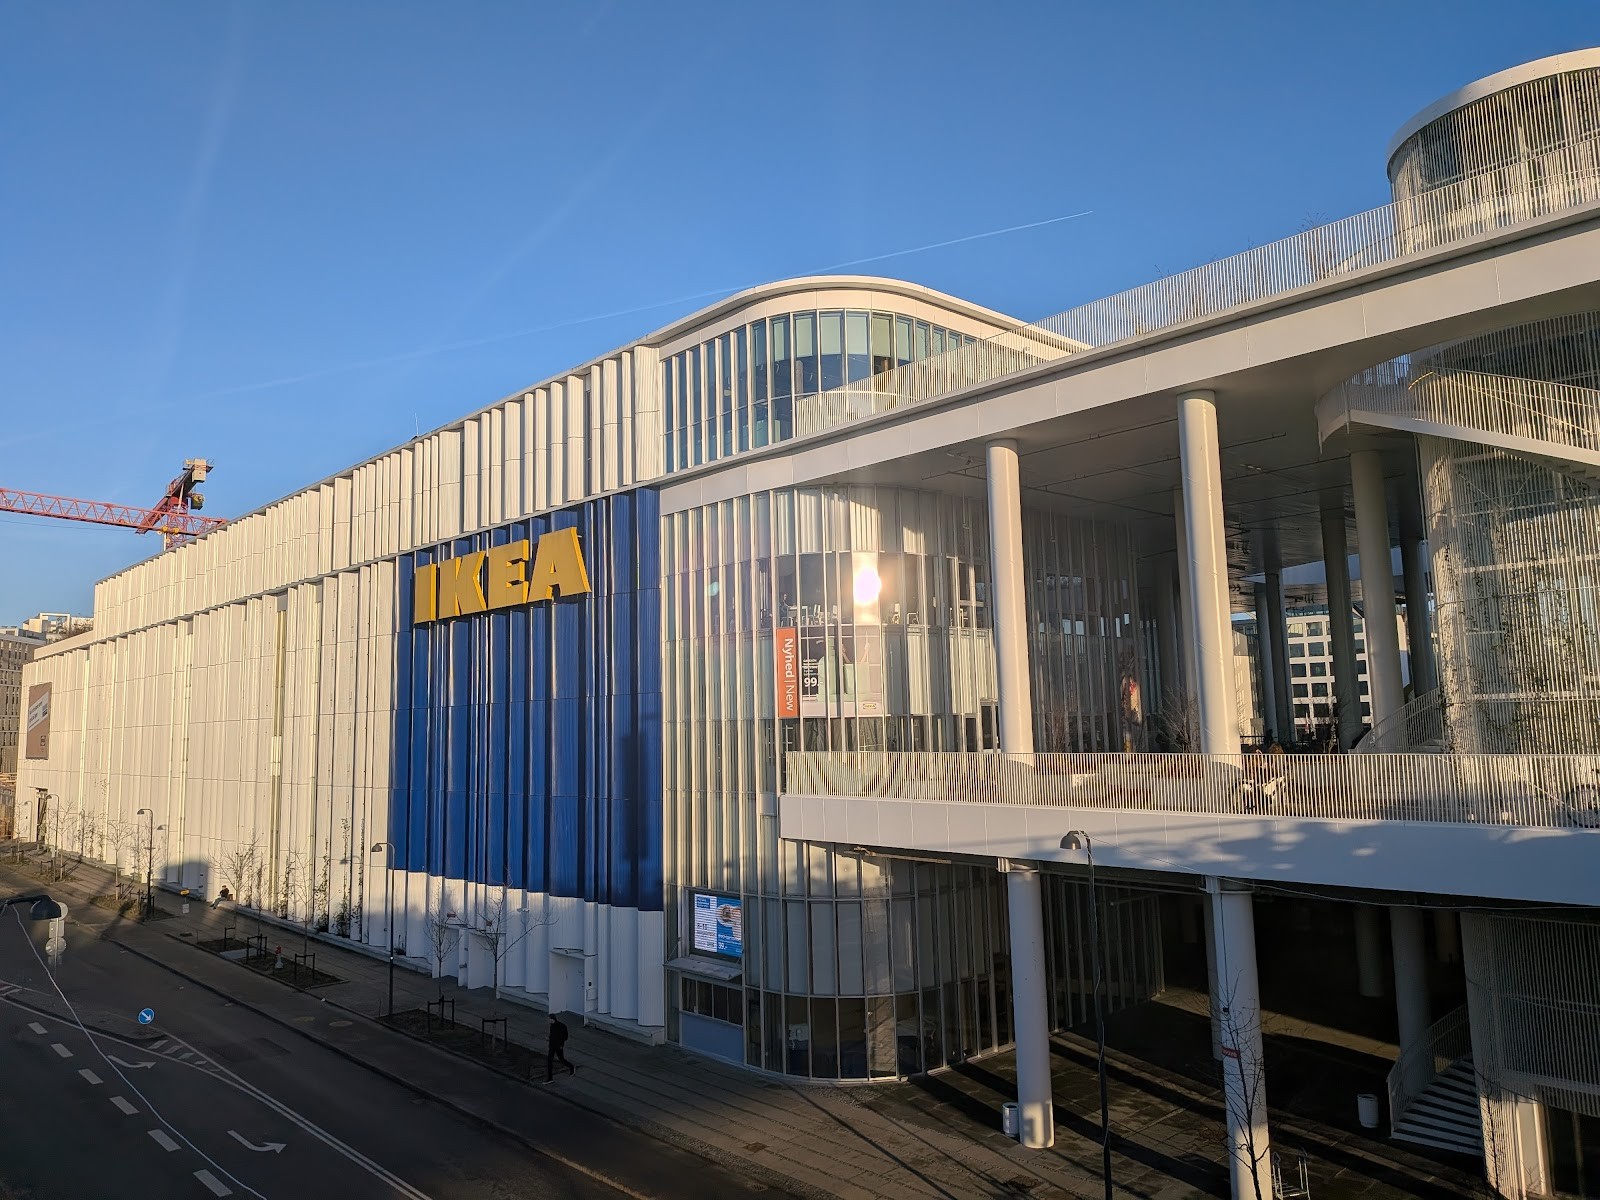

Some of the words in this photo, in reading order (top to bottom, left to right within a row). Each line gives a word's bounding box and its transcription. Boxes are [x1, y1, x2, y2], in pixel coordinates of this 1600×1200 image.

[414, 526, 592, 624] IKEA
[782, 638, 794, 678] Nyhed
[785, 685, 796, 711] New
